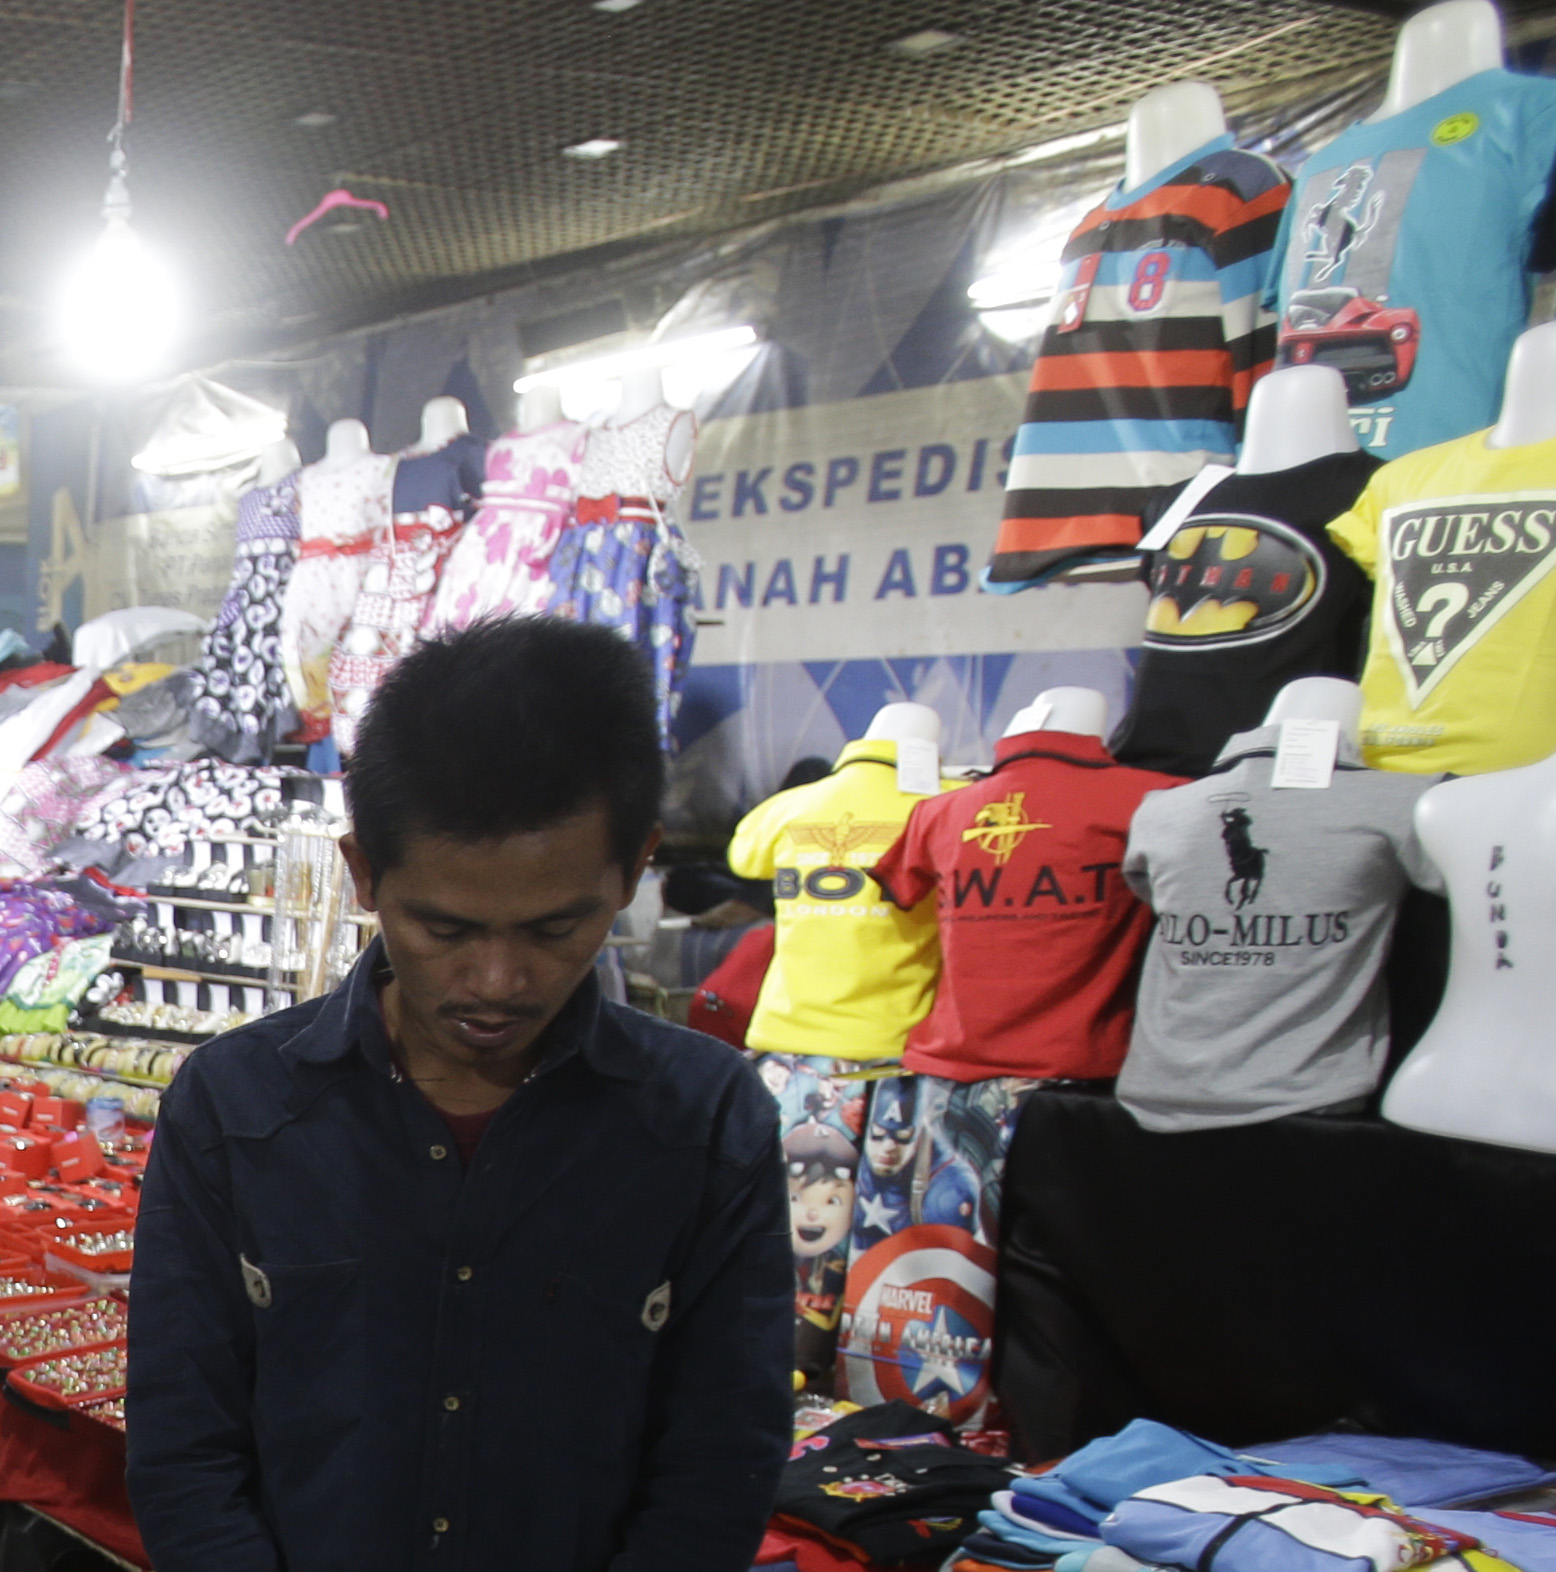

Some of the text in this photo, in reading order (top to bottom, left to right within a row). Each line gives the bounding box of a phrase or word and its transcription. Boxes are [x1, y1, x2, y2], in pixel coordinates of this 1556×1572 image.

[1129, 252, 1171, 311] 8
[1391, 510, 1556, 561] GUESS
[1467, 580, 1506, 619] JEANS
[881, 1283, 933, 1315] MARVEL
